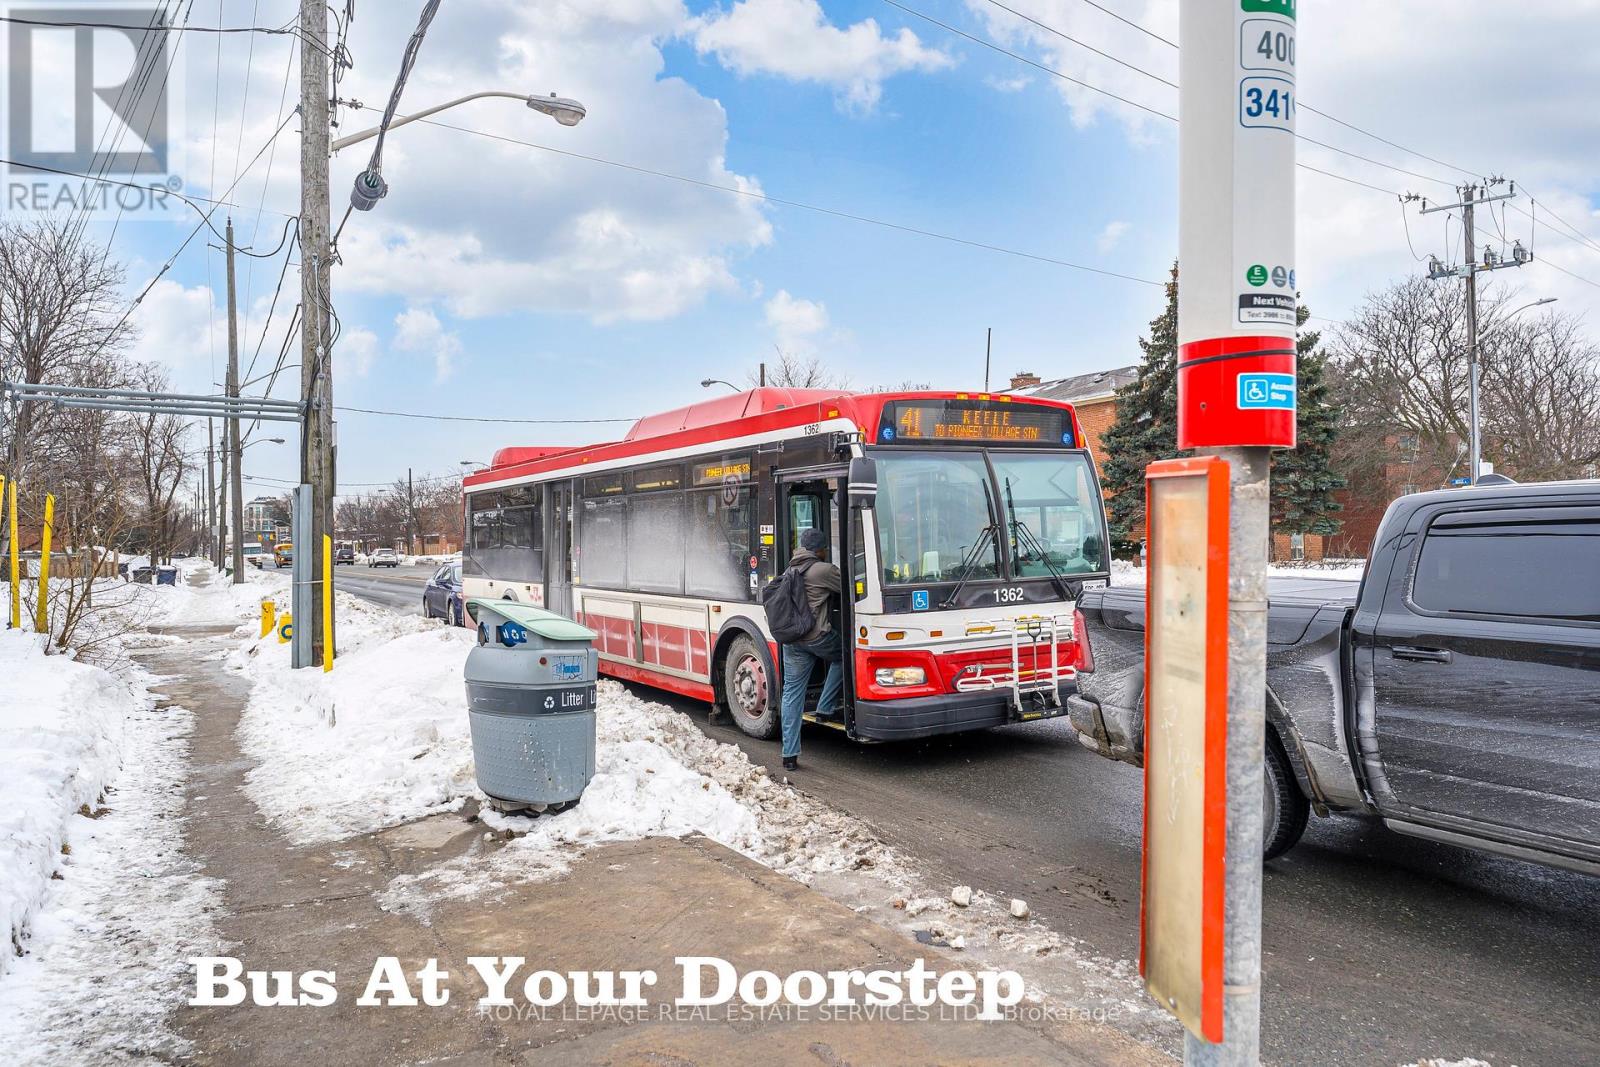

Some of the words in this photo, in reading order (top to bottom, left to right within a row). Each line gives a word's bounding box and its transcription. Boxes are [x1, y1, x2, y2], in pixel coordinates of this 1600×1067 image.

[1246, 87, 1296, 120] 341
[1253, 296, 1275, 306] Next
[901, 407, 921, 437] 41
[962, 410, 1010, 426] KEELE
[804, 423, 820, 436] 1362
[993, 588, 1024, 602] 1362
[561, 691, 584, 707] Litter
